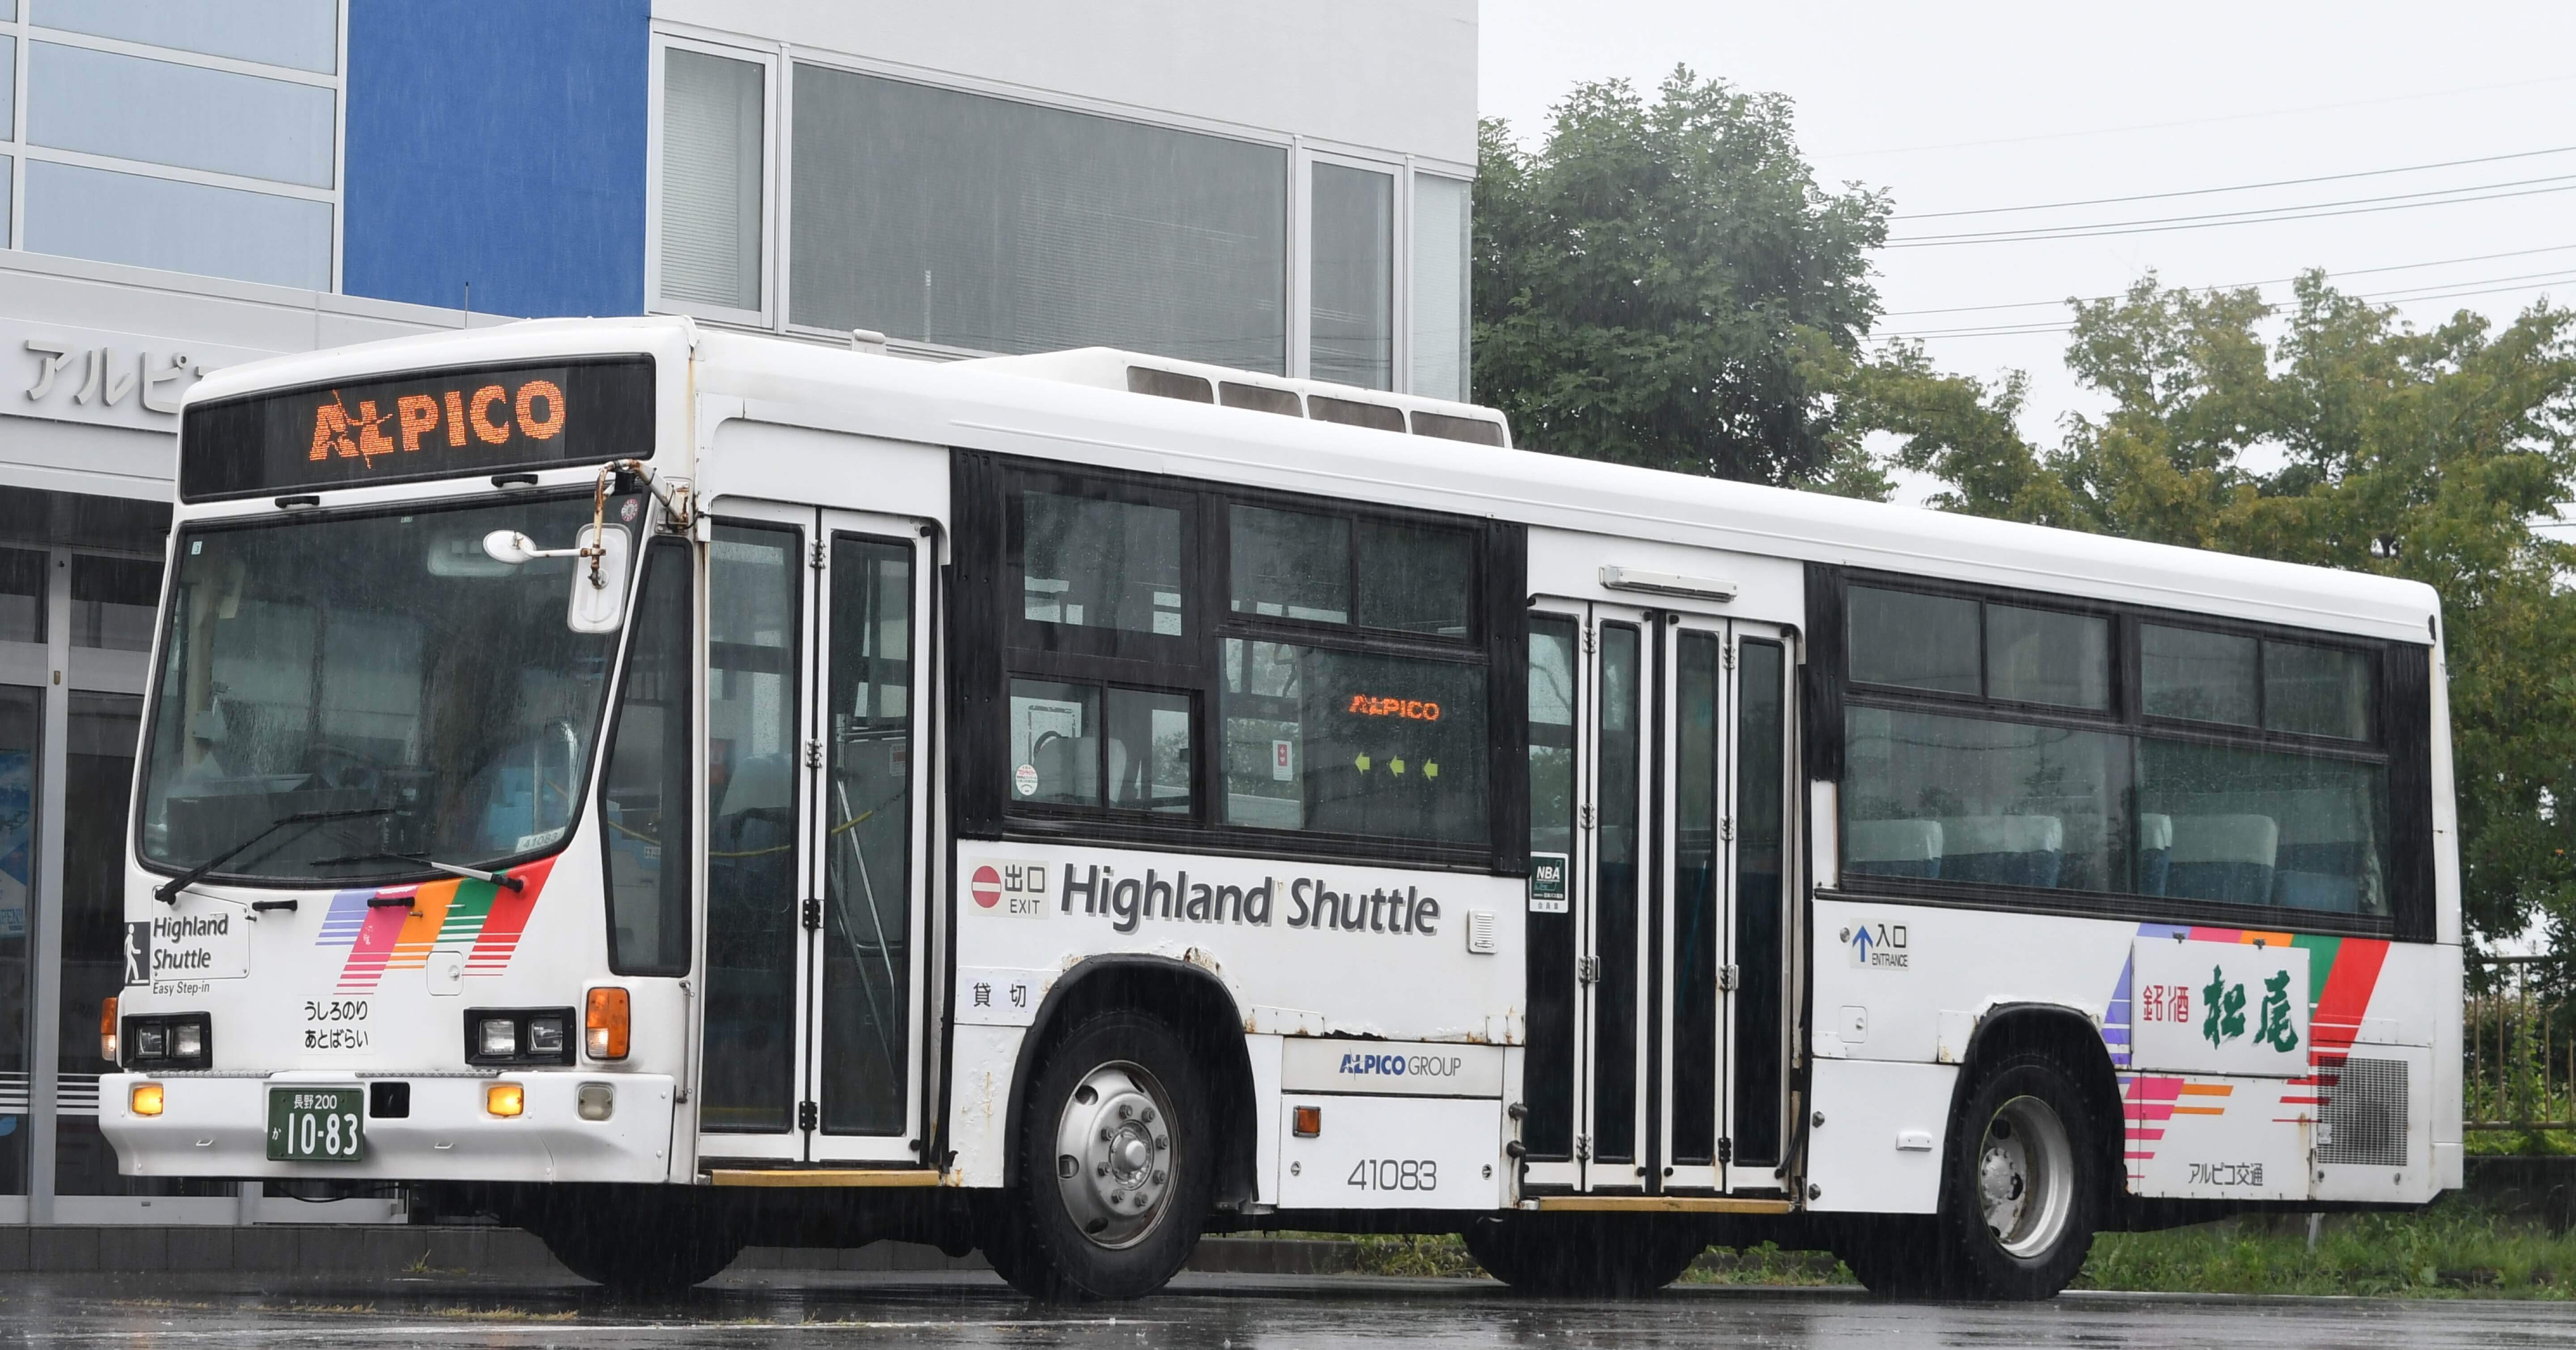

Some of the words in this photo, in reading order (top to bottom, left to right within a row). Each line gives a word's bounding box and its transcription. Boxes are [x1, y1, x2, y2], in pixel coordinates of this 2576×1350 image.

[25, 339, 222, 414] アルピ
[309, 380, 565, 465] ALPICO
[1348, 694, 1440, 721] ALPICO
[1005, 864, 1045, 893] 出口
[1536, 866, 1560, 879] NBA
[1010, 898, 1040, 915] EXIT
[1061, 863, 1275, 934] Highland
[1287, 877, 1441, 936] Shuttle
[153, 913, 229, 944] Highland
[1876, 923, 1907, 948] 入口
[153, 947, 212, 970] Shuttle
[1872, 953, 1908, 968] ENTRANCE
[153, 982, 174, 997] Easy
[176, 980, 210, 997] Step-in
[973, 982, 1026, 1008] 貸切
[304, 1000, 368, 1021] うしろのり
[2143, 985, 2189, 1023] 銘酒
[2202, 964, 2299, 1053] 松尾
[304, 1028, 369, 1049] あとばらい
[1339, 1052, 1407, 1076] ALPICO
[1408, 1056, 1462, 1077] GROUP
[271, 1127, 282, 1141] か
[288, 1112, 358, 1155] 10-83
[1347, 1159, 1437, 1191] 41083
[2188, 1162, 2263, 1186] アルピコ交通
